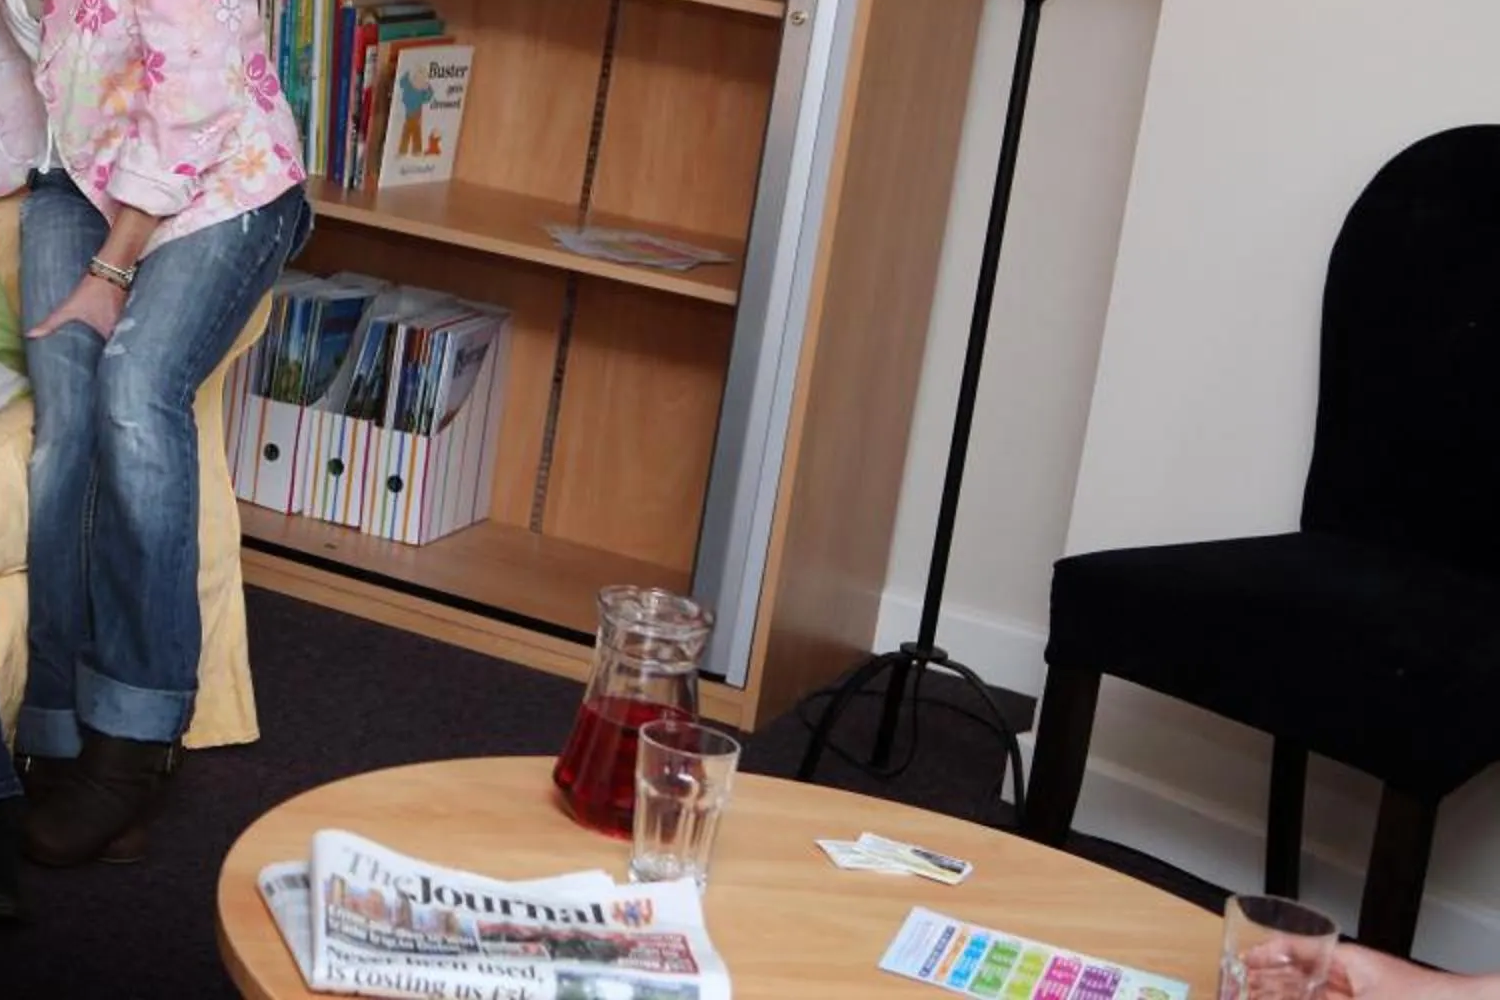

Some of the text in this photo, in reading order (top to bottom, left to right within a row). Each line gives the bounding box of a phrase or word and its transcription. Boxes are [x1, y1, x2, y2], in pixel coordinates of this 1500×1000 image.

[428, 61, 468, 79] Buster
[343, 846, 417, 902] The
[417, 874, 606, 926] Journal
